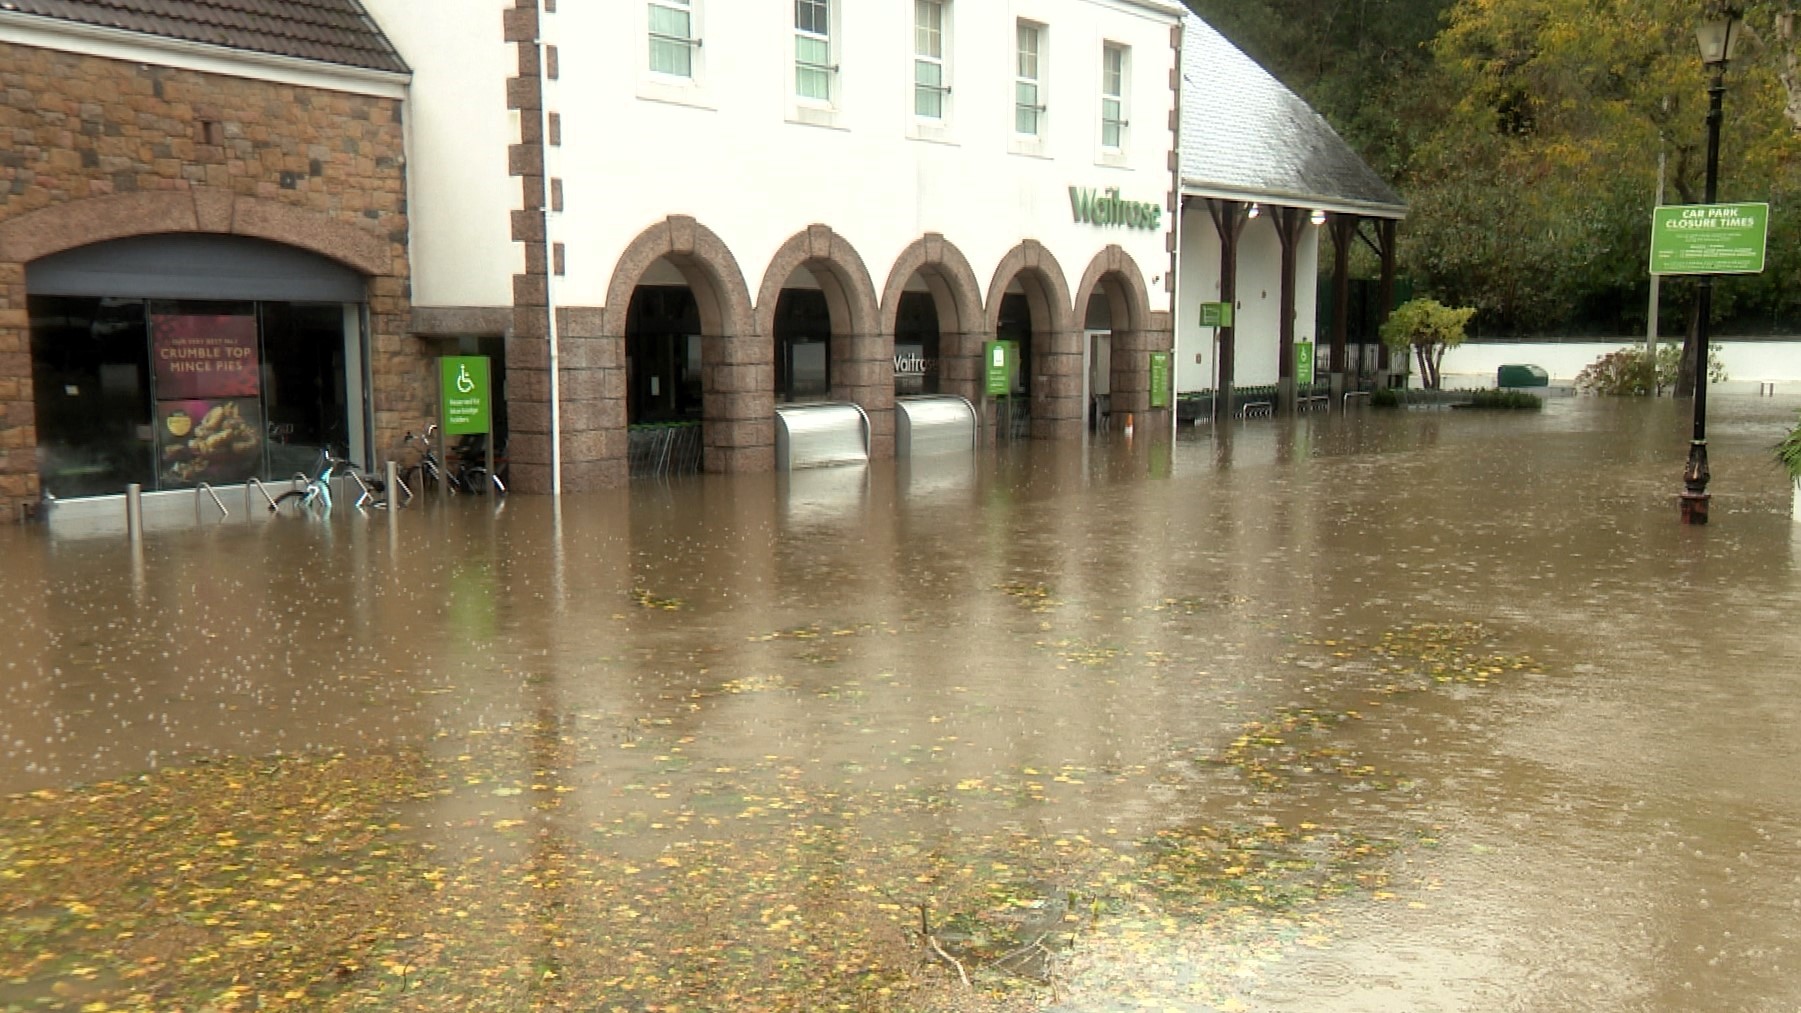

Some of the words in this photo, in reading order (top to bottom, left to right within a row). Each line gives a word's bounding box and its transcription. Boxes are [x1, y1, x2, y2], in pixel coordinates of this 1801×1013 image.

[1068, 186, 1161, 230] Waitrose
[1682, 210, 1705, 219] CAR
[1708, 208, 1738, 218] PARK
[1665, 219, 1717, 229] CLOSURE
[1721, 217, 1754, 227] TIMES
[160, 348, 220, 359] CRUMBLE
[226, 347, 251, 358] TOP
[170, 362, 212, 373] MINCE
[216, 361, 242, 371] PIES
